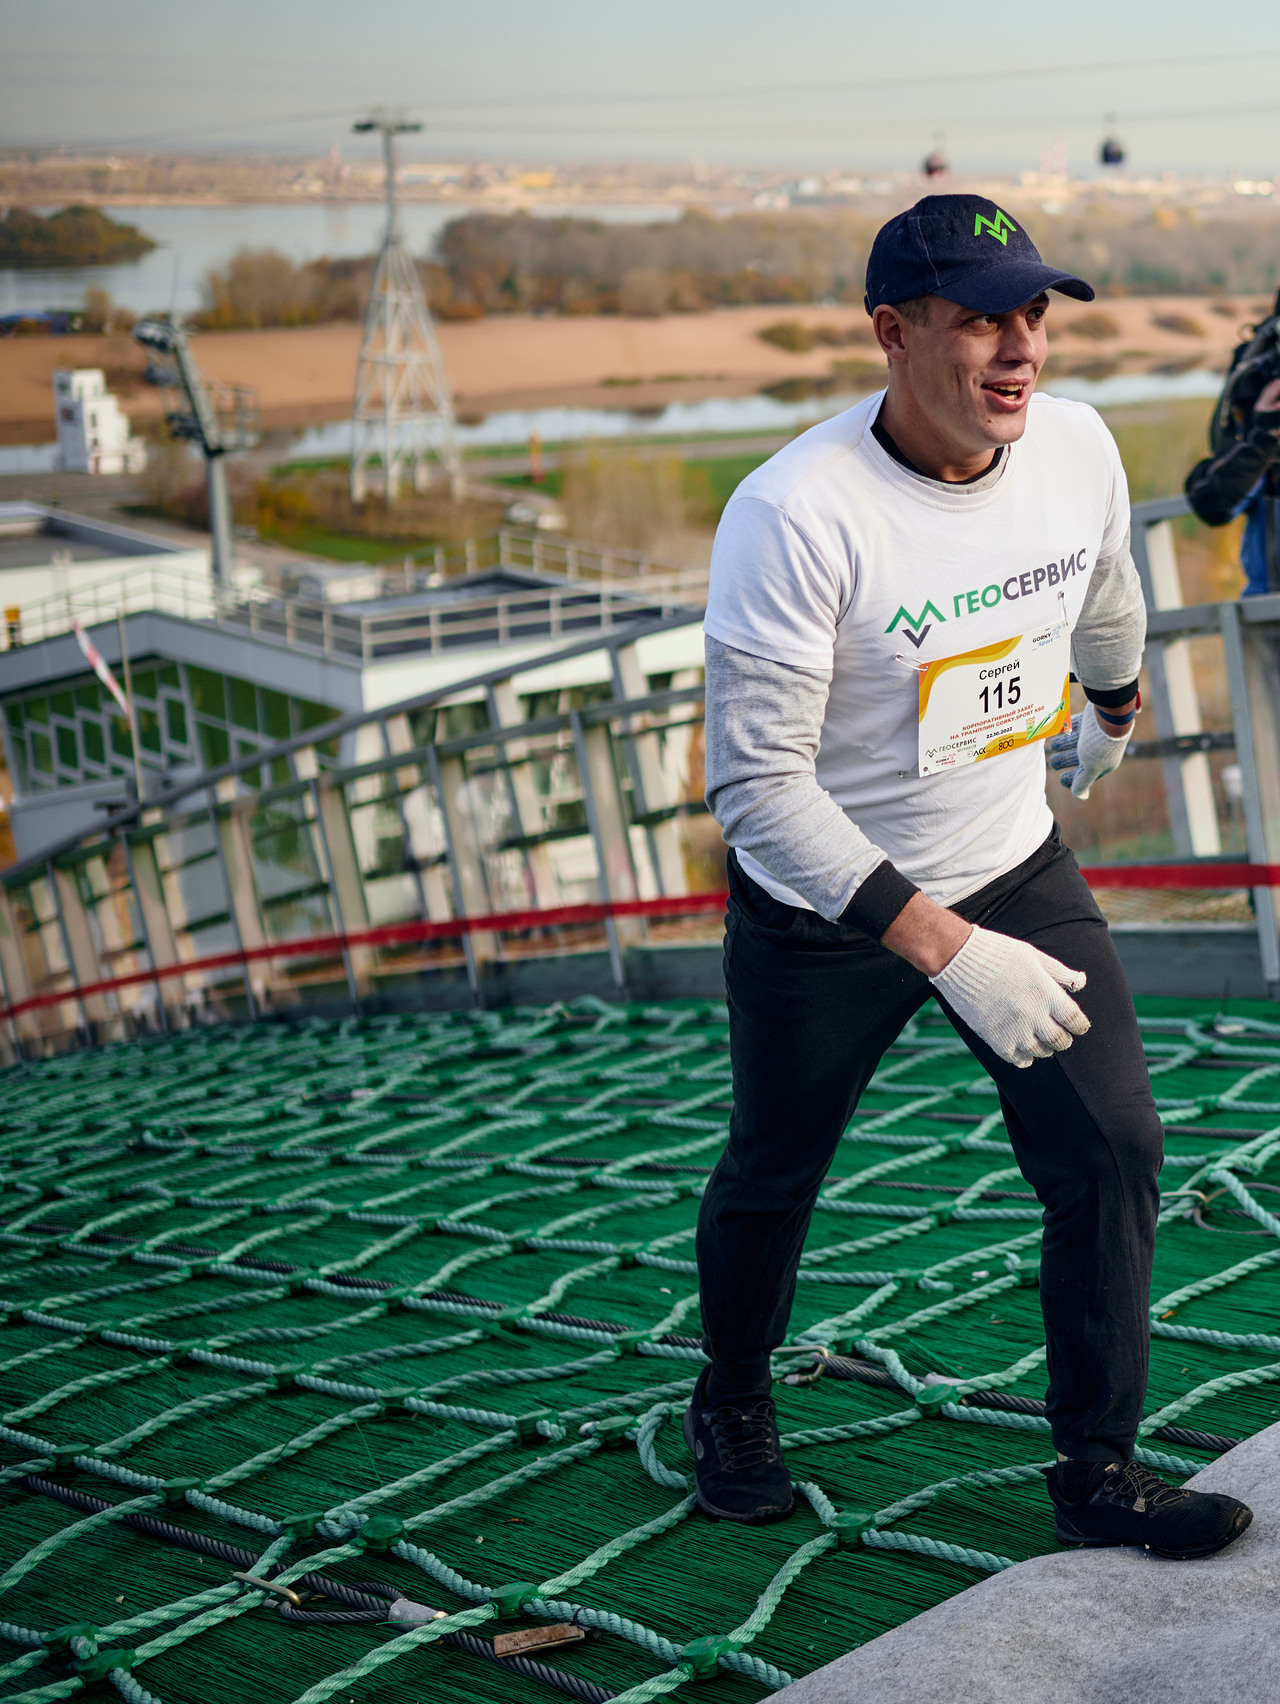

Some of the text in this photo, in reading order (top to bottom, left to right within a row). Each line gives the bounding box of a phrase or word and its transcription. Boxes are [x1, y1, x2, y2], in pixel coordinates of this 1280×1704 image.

[953, 548, 1087, 618] ГЕОСЕРВИС
[979, 659, 1020, 680] Сергей
[978, 676, 1021, 713] 115
[962, 709, 1016, 731] КОРПОРАТИВНЫЙ
[1017, 704, 1034, 714] ЗАБЕГ
[961, 724, 995, 737] ТРАМПЛИН
[939, 737, 977, 752] ГЕОСЕРВИС
[998, 739, 1014, 750] 800
